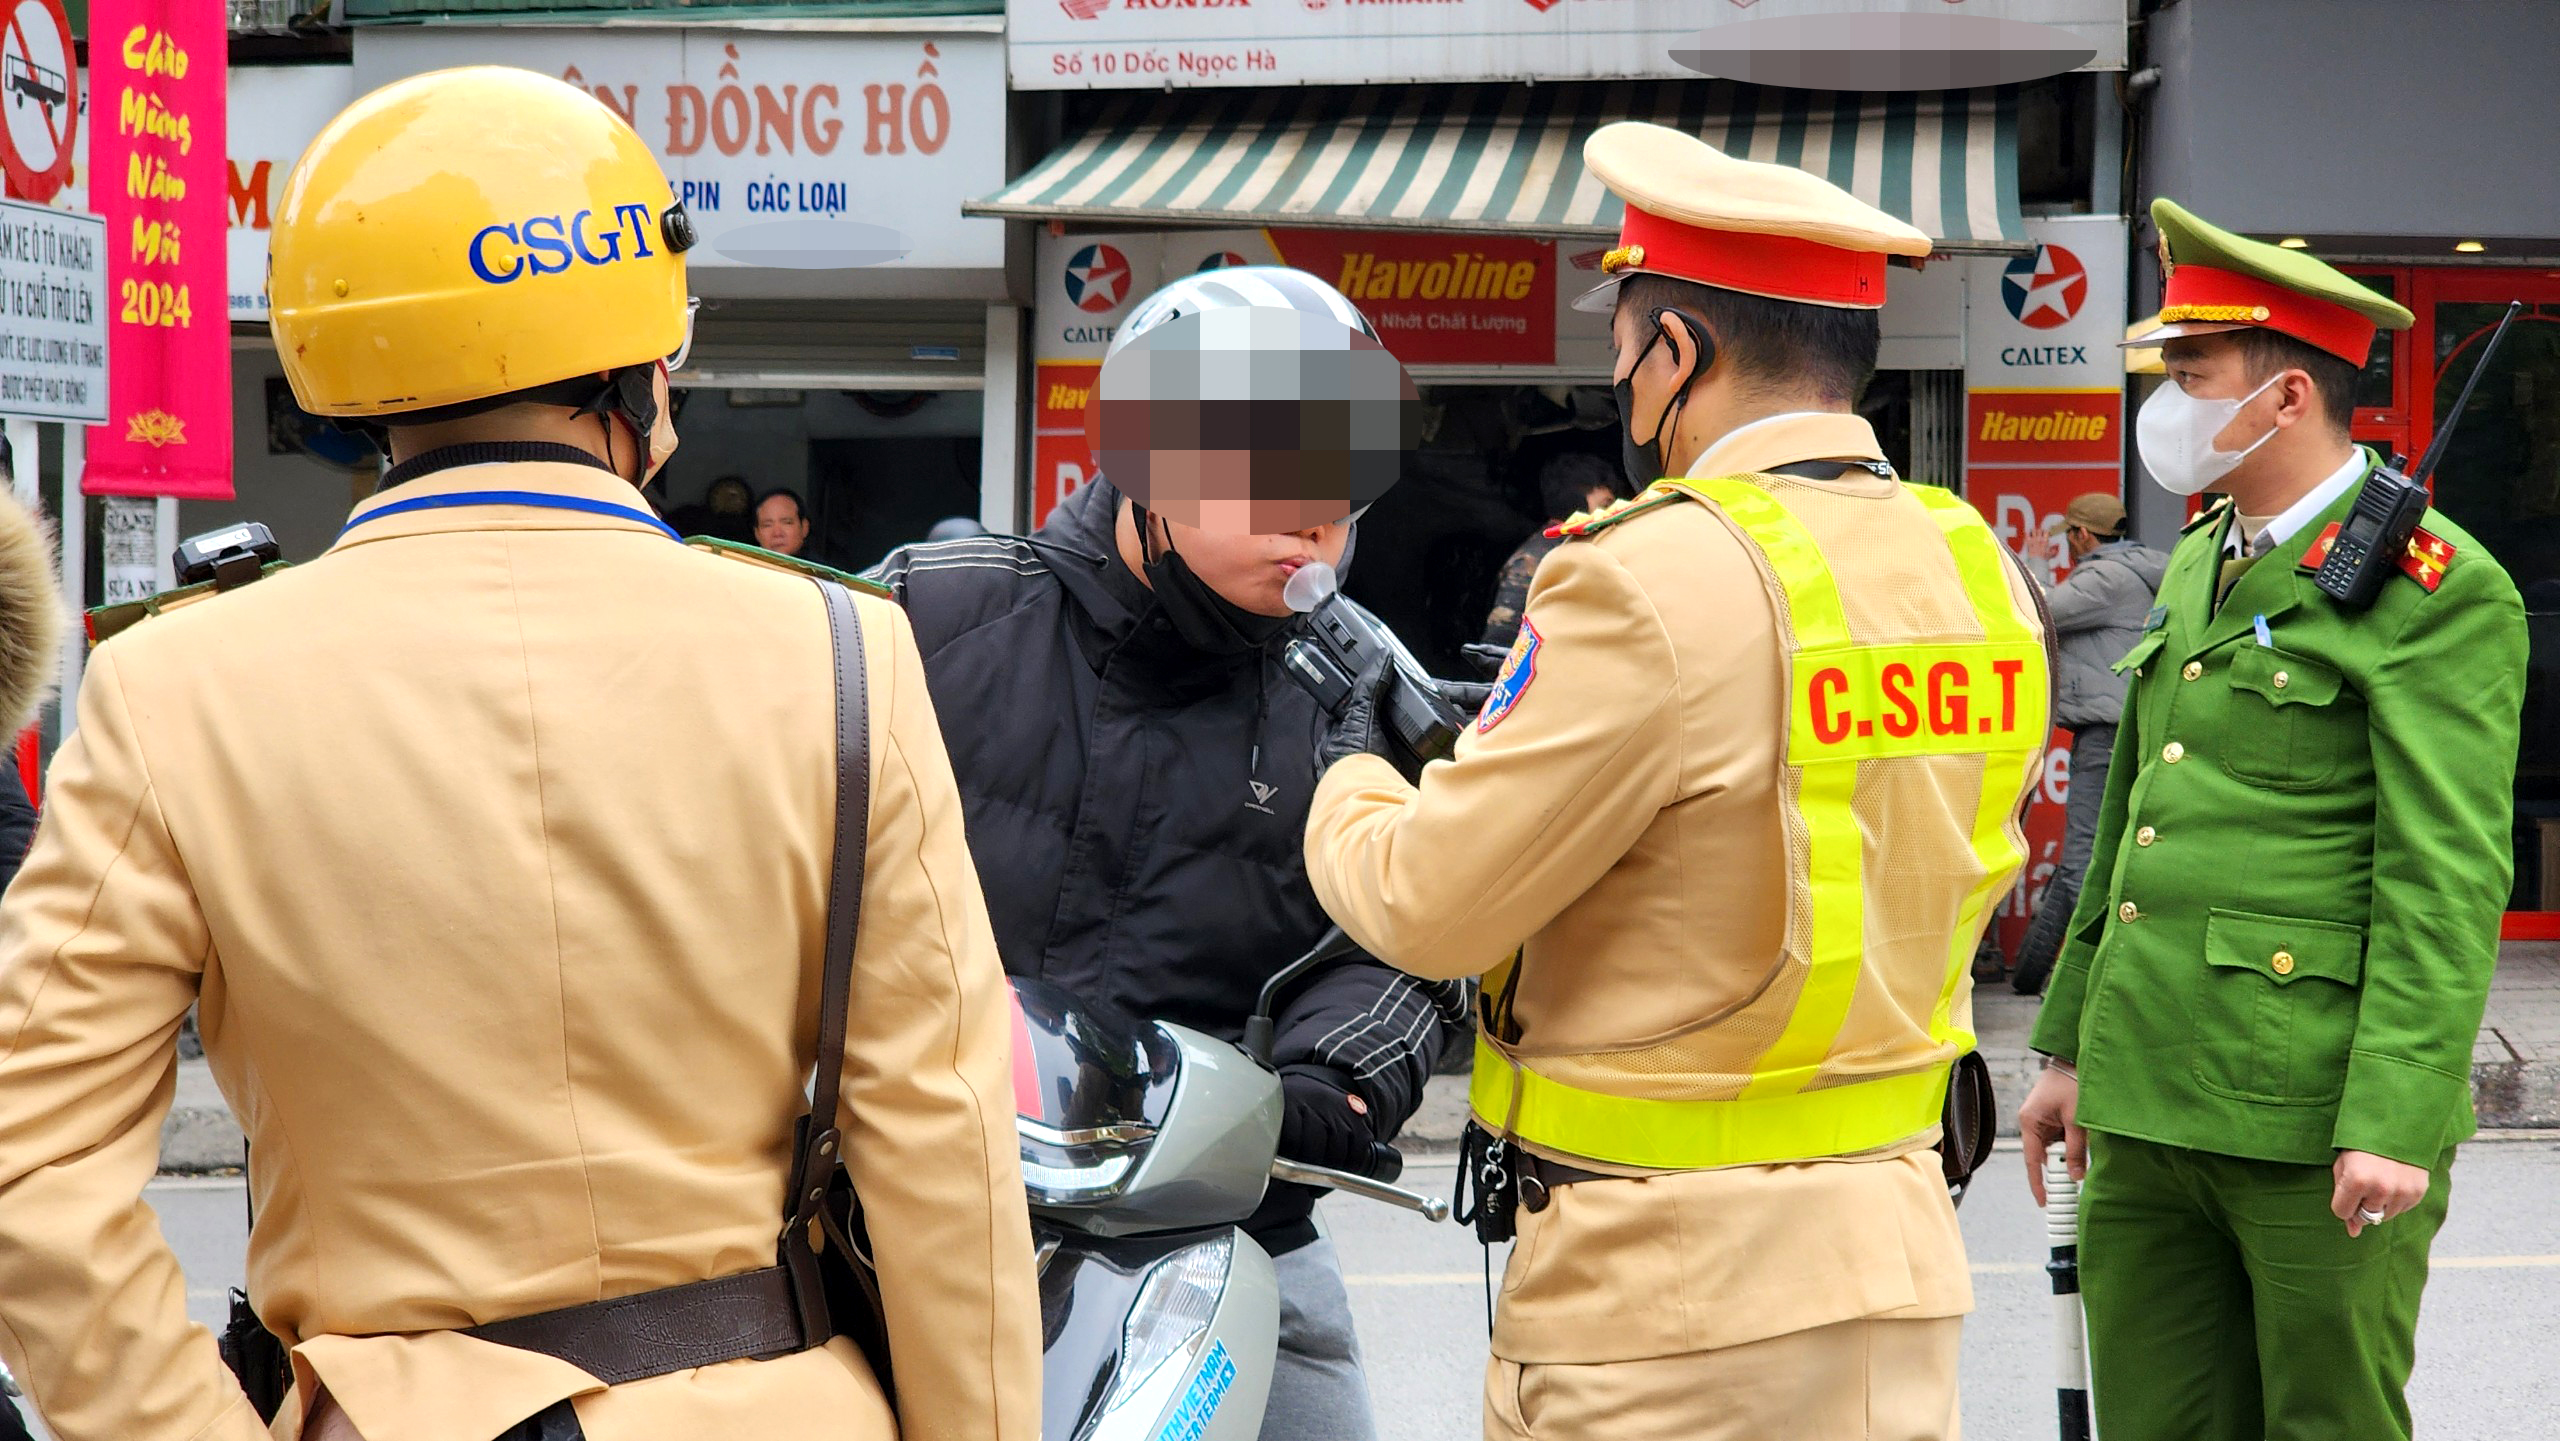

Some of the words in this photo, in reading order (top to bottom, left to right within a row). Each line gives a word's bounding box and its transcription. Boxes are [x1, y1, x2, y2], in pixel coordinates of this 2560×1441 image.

[123, 24, 189, 80] Chào
[1053, 50, 1083, 75] Số
[1092, 53, 1116, 74] 10
[1124, 49, 1170, 73] Dốc
[1178, 51, 1238, 78] Ngọc
[1247, 50, 1277, 71] Hà
[664, 42, 843, 157] ĐỒNG
[863, 40, 951, 156] HỒ
[683, 181, 720, 211] PIN
[747, 174, 791, 212] CÁC
[798, 182, 847, 218] LOẠI
[15, 224, 29, 262] XE
[32, 221, 39, 263] Ô
[43, 223, 55, 266] TÔ
[469, 203, 654, 284] CSGT
[1339, 253, 1538, 300] Havoline
[11, 280, 23, 317] 16
[73, 281, 93, 325] LÊN
[120, 278, 192, 328] 2024
[2001, 346, 2088, 366] CALTEX
[1980, 410, 2108, 442] Havoline
[1809, 659, 2024, 745] C.SG.T
